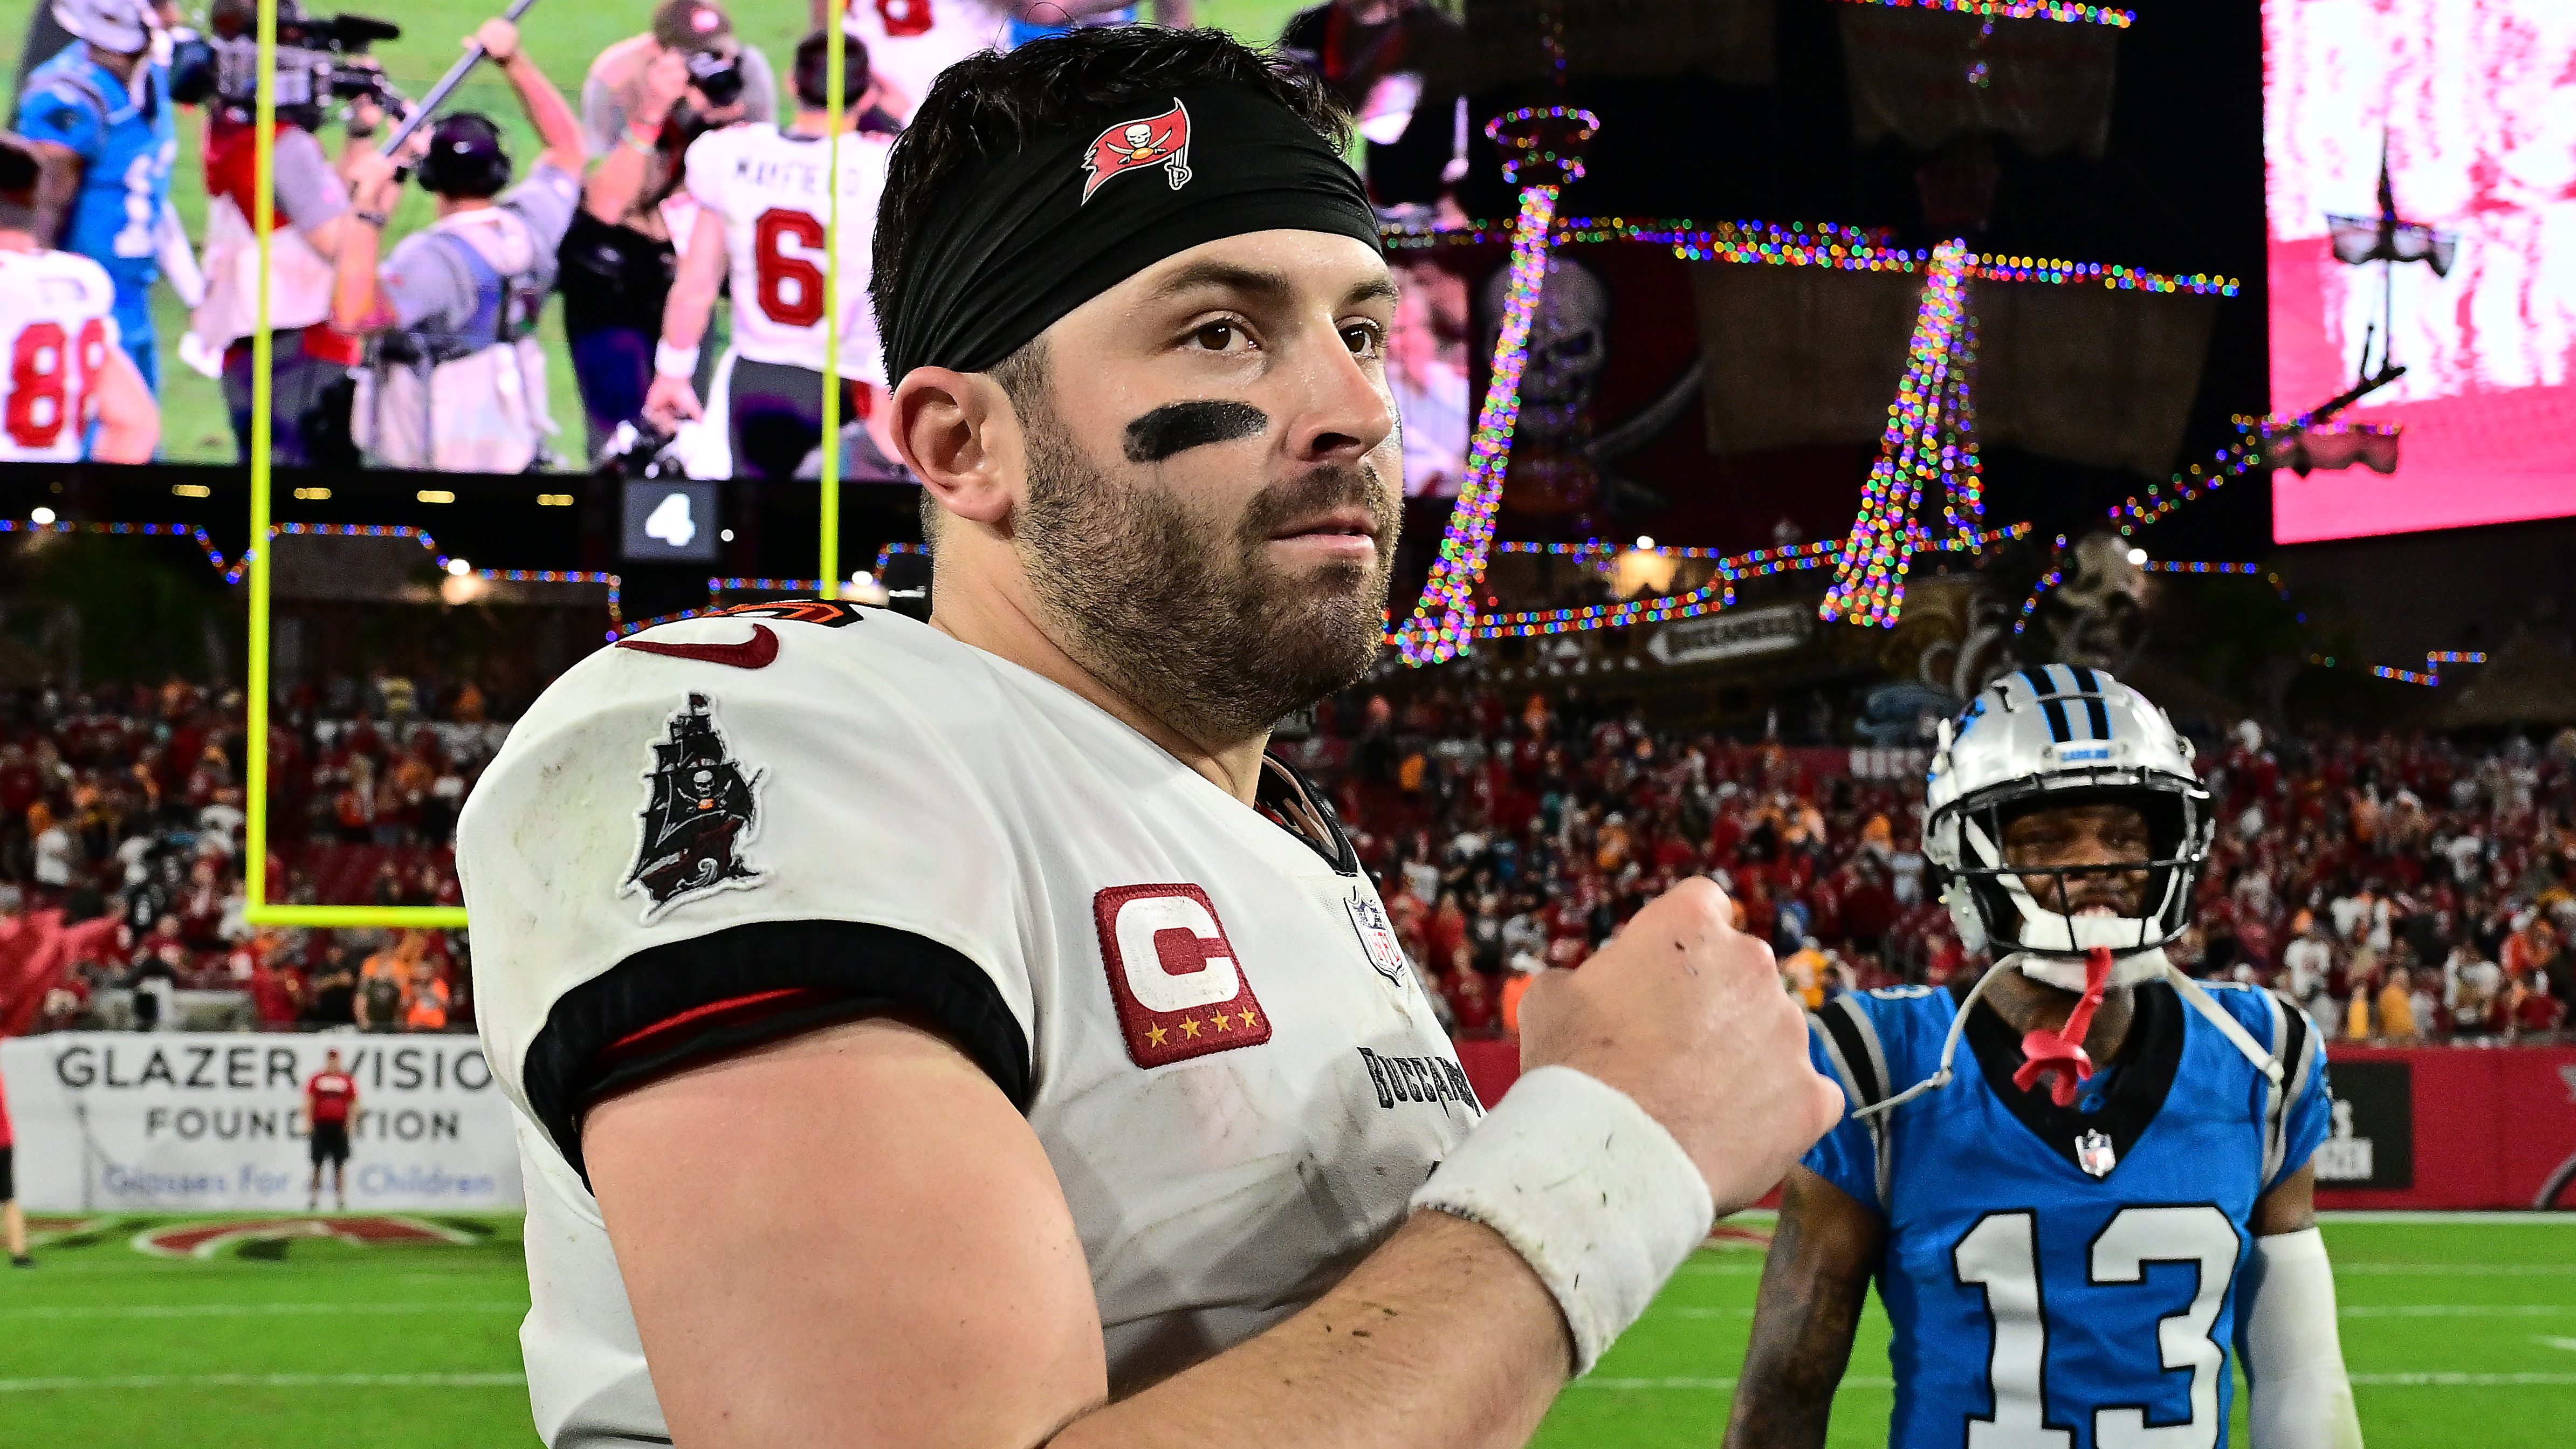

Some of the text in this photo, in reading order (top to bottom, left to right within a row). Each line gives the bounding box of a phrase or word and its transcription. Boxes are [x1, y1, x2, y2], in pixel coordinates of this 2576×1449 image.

[734, 159, 861, 196] MAYFIED
[756, 207, 825, 328] 6
[645, 493, 696, 546] 4
[1115, 895, 1240, 1013] C
[56, 1045, 298, 1089] GLAZER
[146, 1106, 461, 1142] FOUNDTION
[239, 1163, 289, 1194] For
[1954, 1203, 2241, 1449] 13
